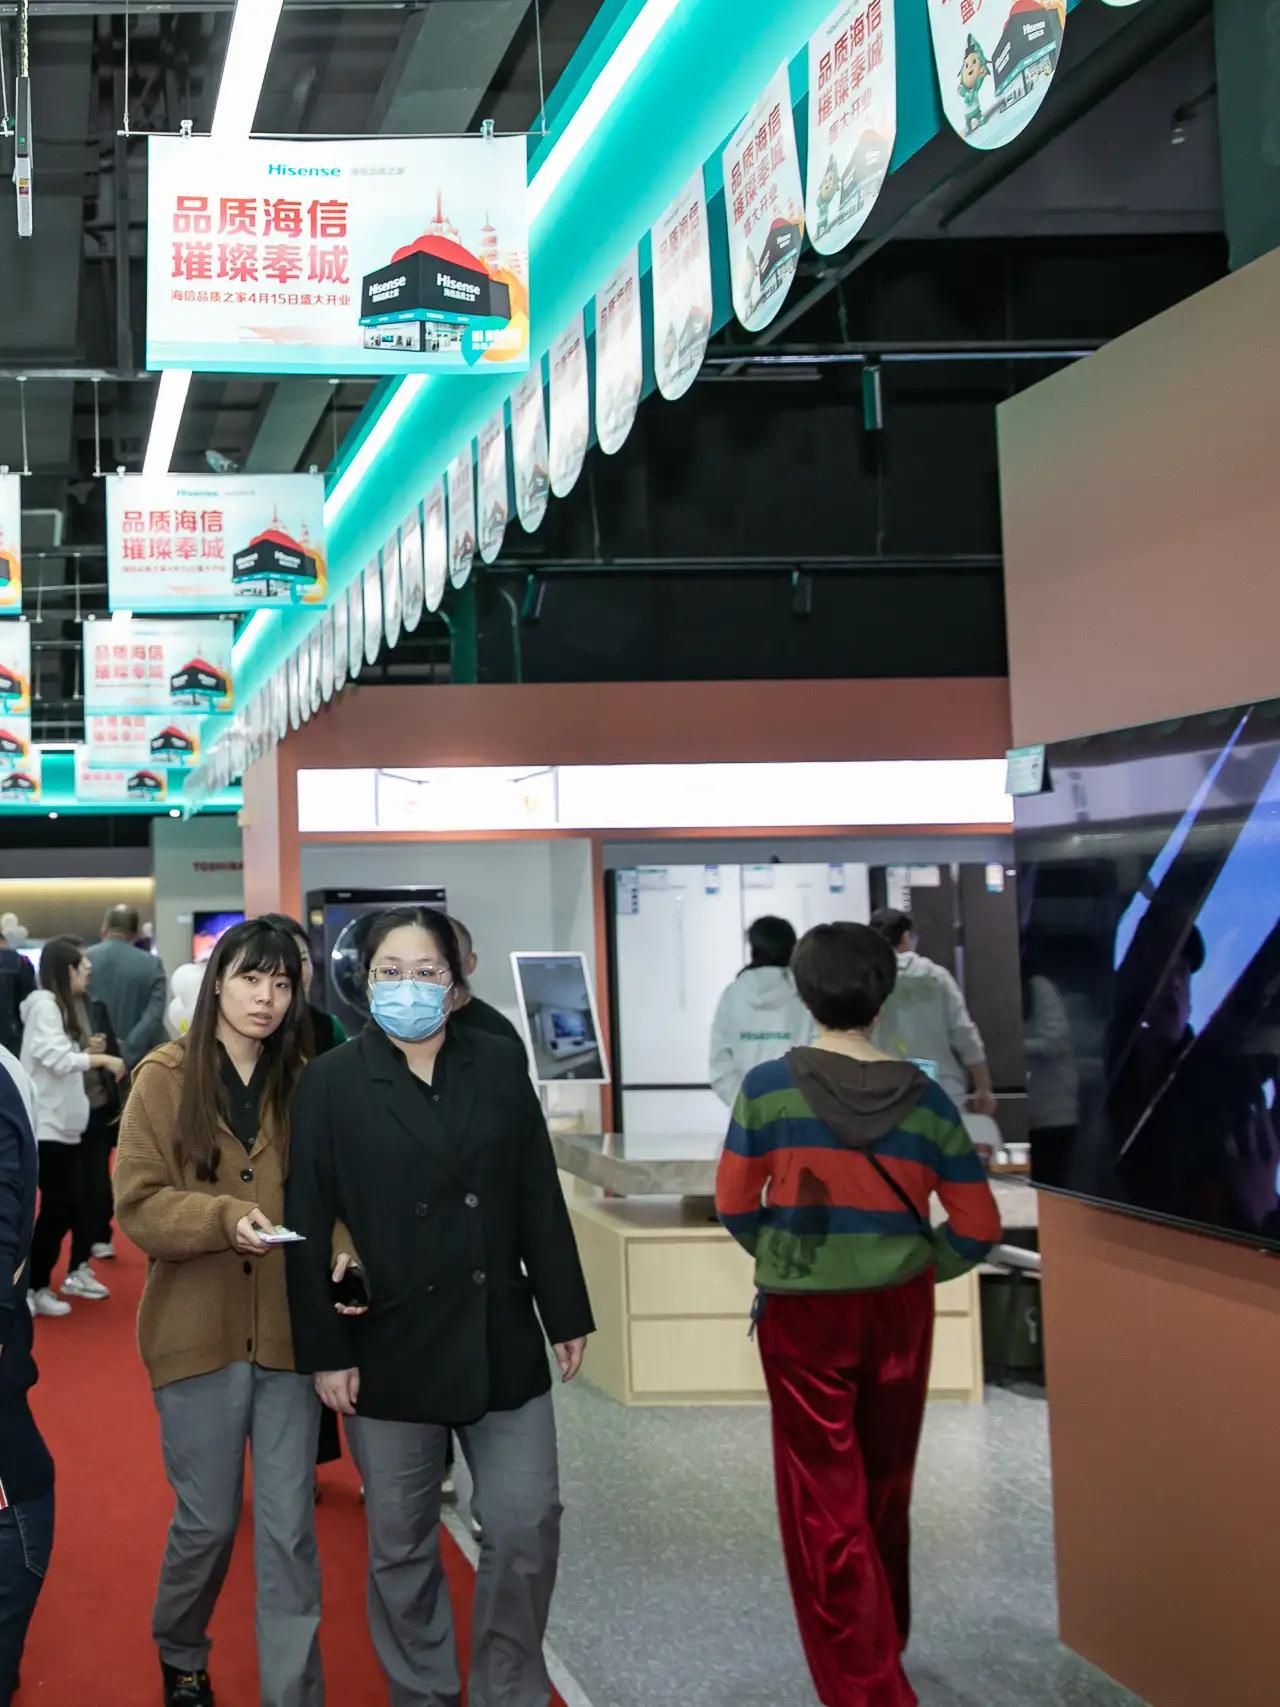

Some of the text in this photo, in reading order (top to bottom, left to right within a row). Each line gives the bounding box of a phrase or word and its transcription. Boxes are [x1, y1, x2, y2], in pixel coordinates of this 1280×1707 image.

[268, 164, 342, 177] Hisense
[173, 196, 349, 239] 品质海信
[171, 241, 350, 285] 璀璨奉城
[369, 276, 406, 297] Hisense
[436, 273, 481, 296] Hisense
[171, 290, 351, 306] 海信品质之家4月15日盛大开业
[123, 510, 223, 533] 品质海信
